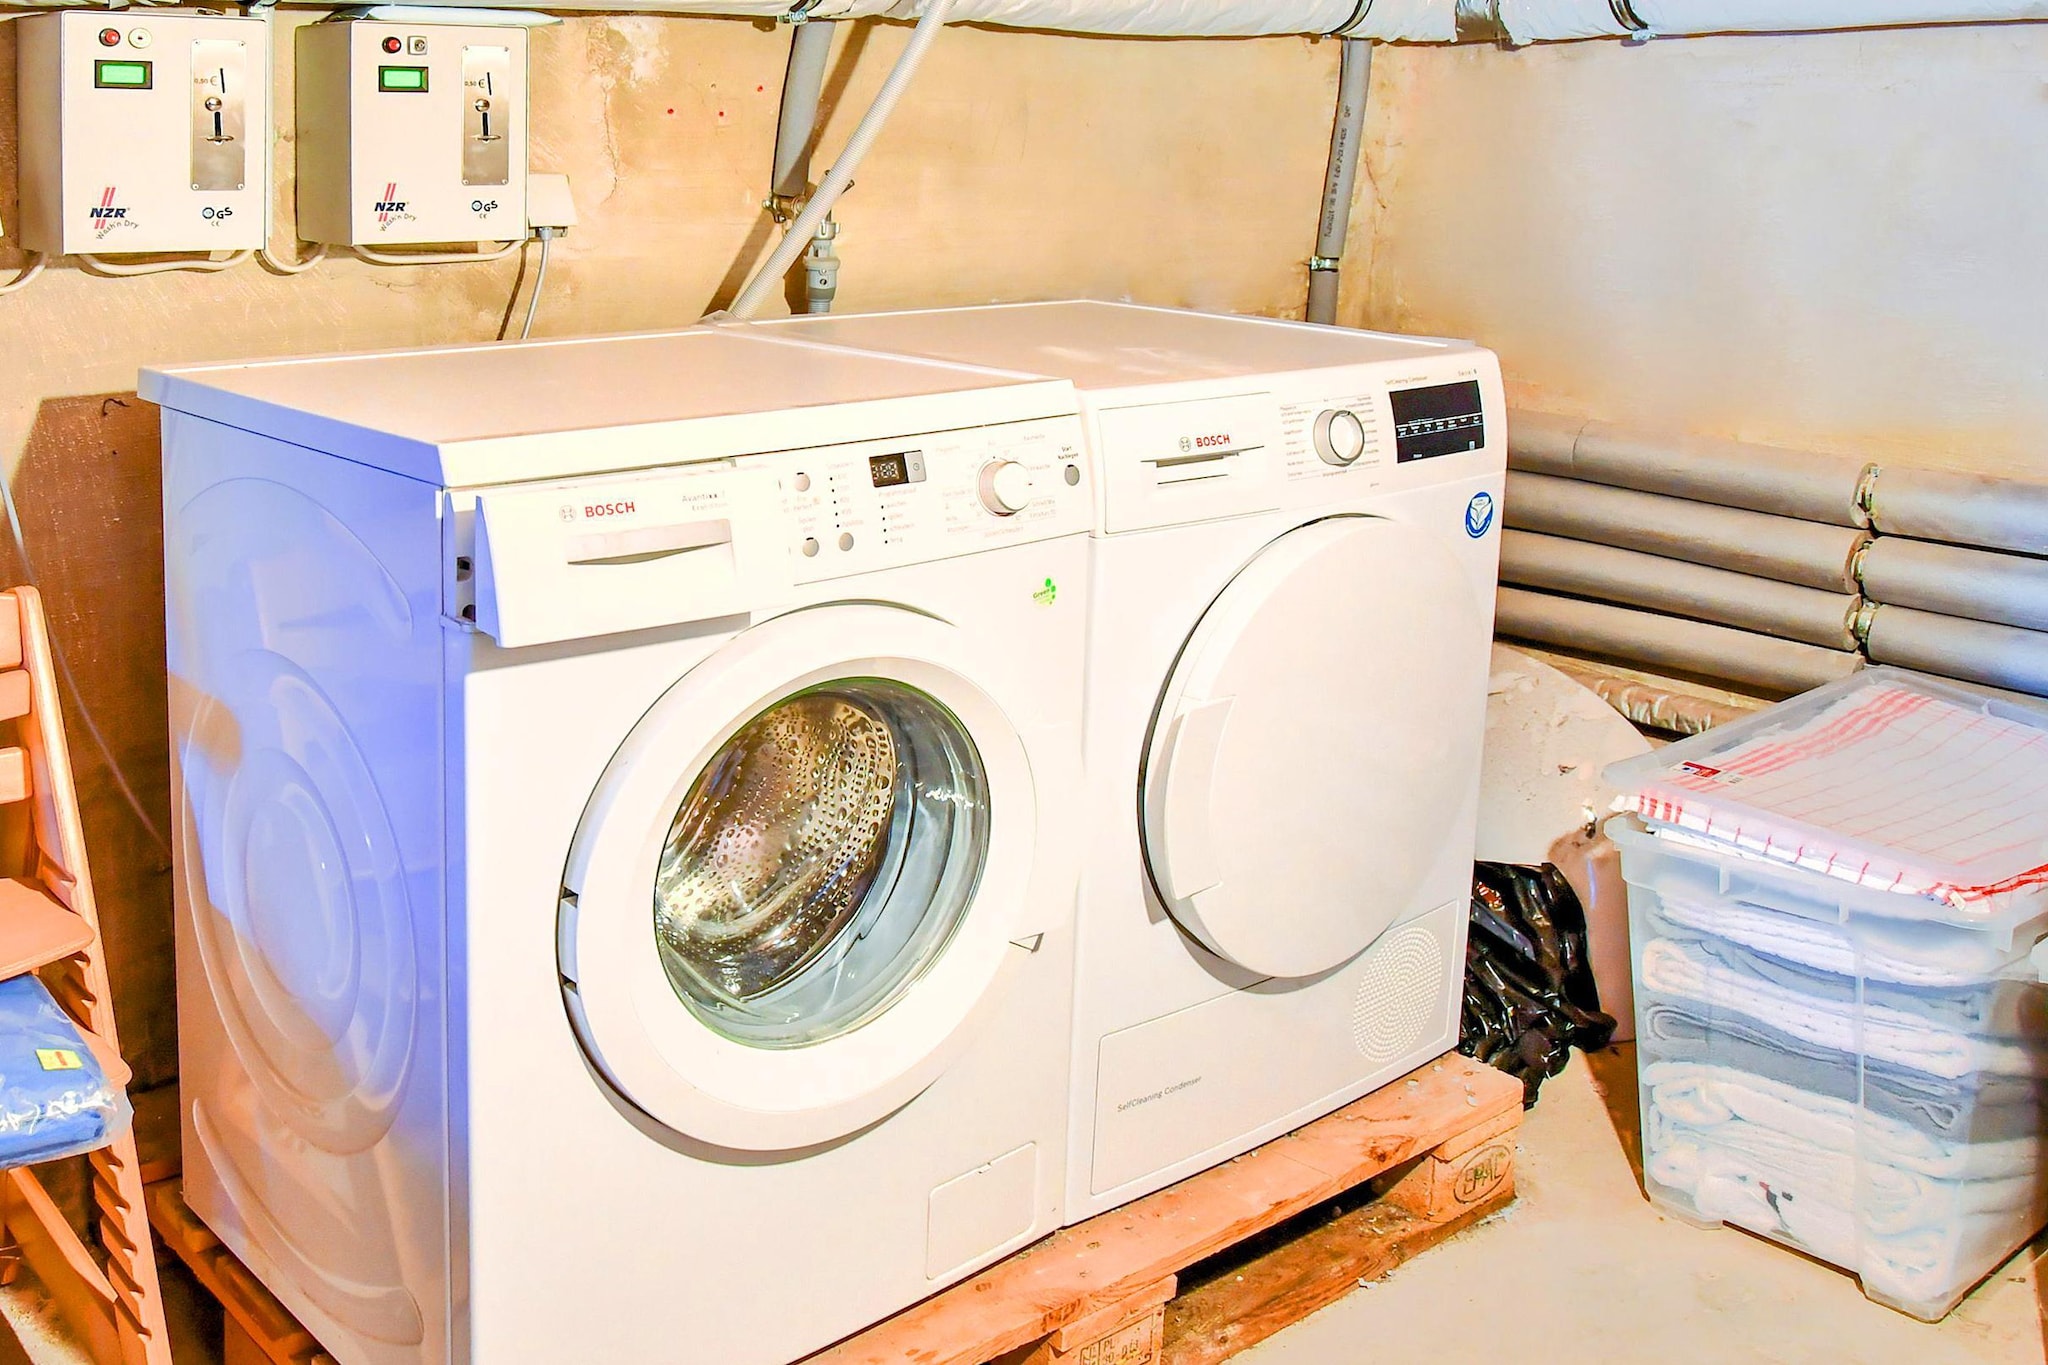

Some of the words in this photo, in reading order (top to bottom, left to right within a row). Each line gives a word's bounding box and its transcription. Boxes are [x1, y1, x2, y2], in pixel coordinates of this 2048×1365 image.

[374, 202, 406, 212] NZR
[483, 200, 498, 212] GS
[89, 207, 127, 218] NZR
[216, 207, 233, 219] GS
[403, 212, 417, 222] Dry
[124, 219, 139, 230] Dry
[1195, 433, 1231, 448] BOSCH
[584, 502, 636, 518] BOSCH
[1117, 1090, 1163, 1113] SelfCleaning
[1164, 1076, 1202, 1096] Condenser
